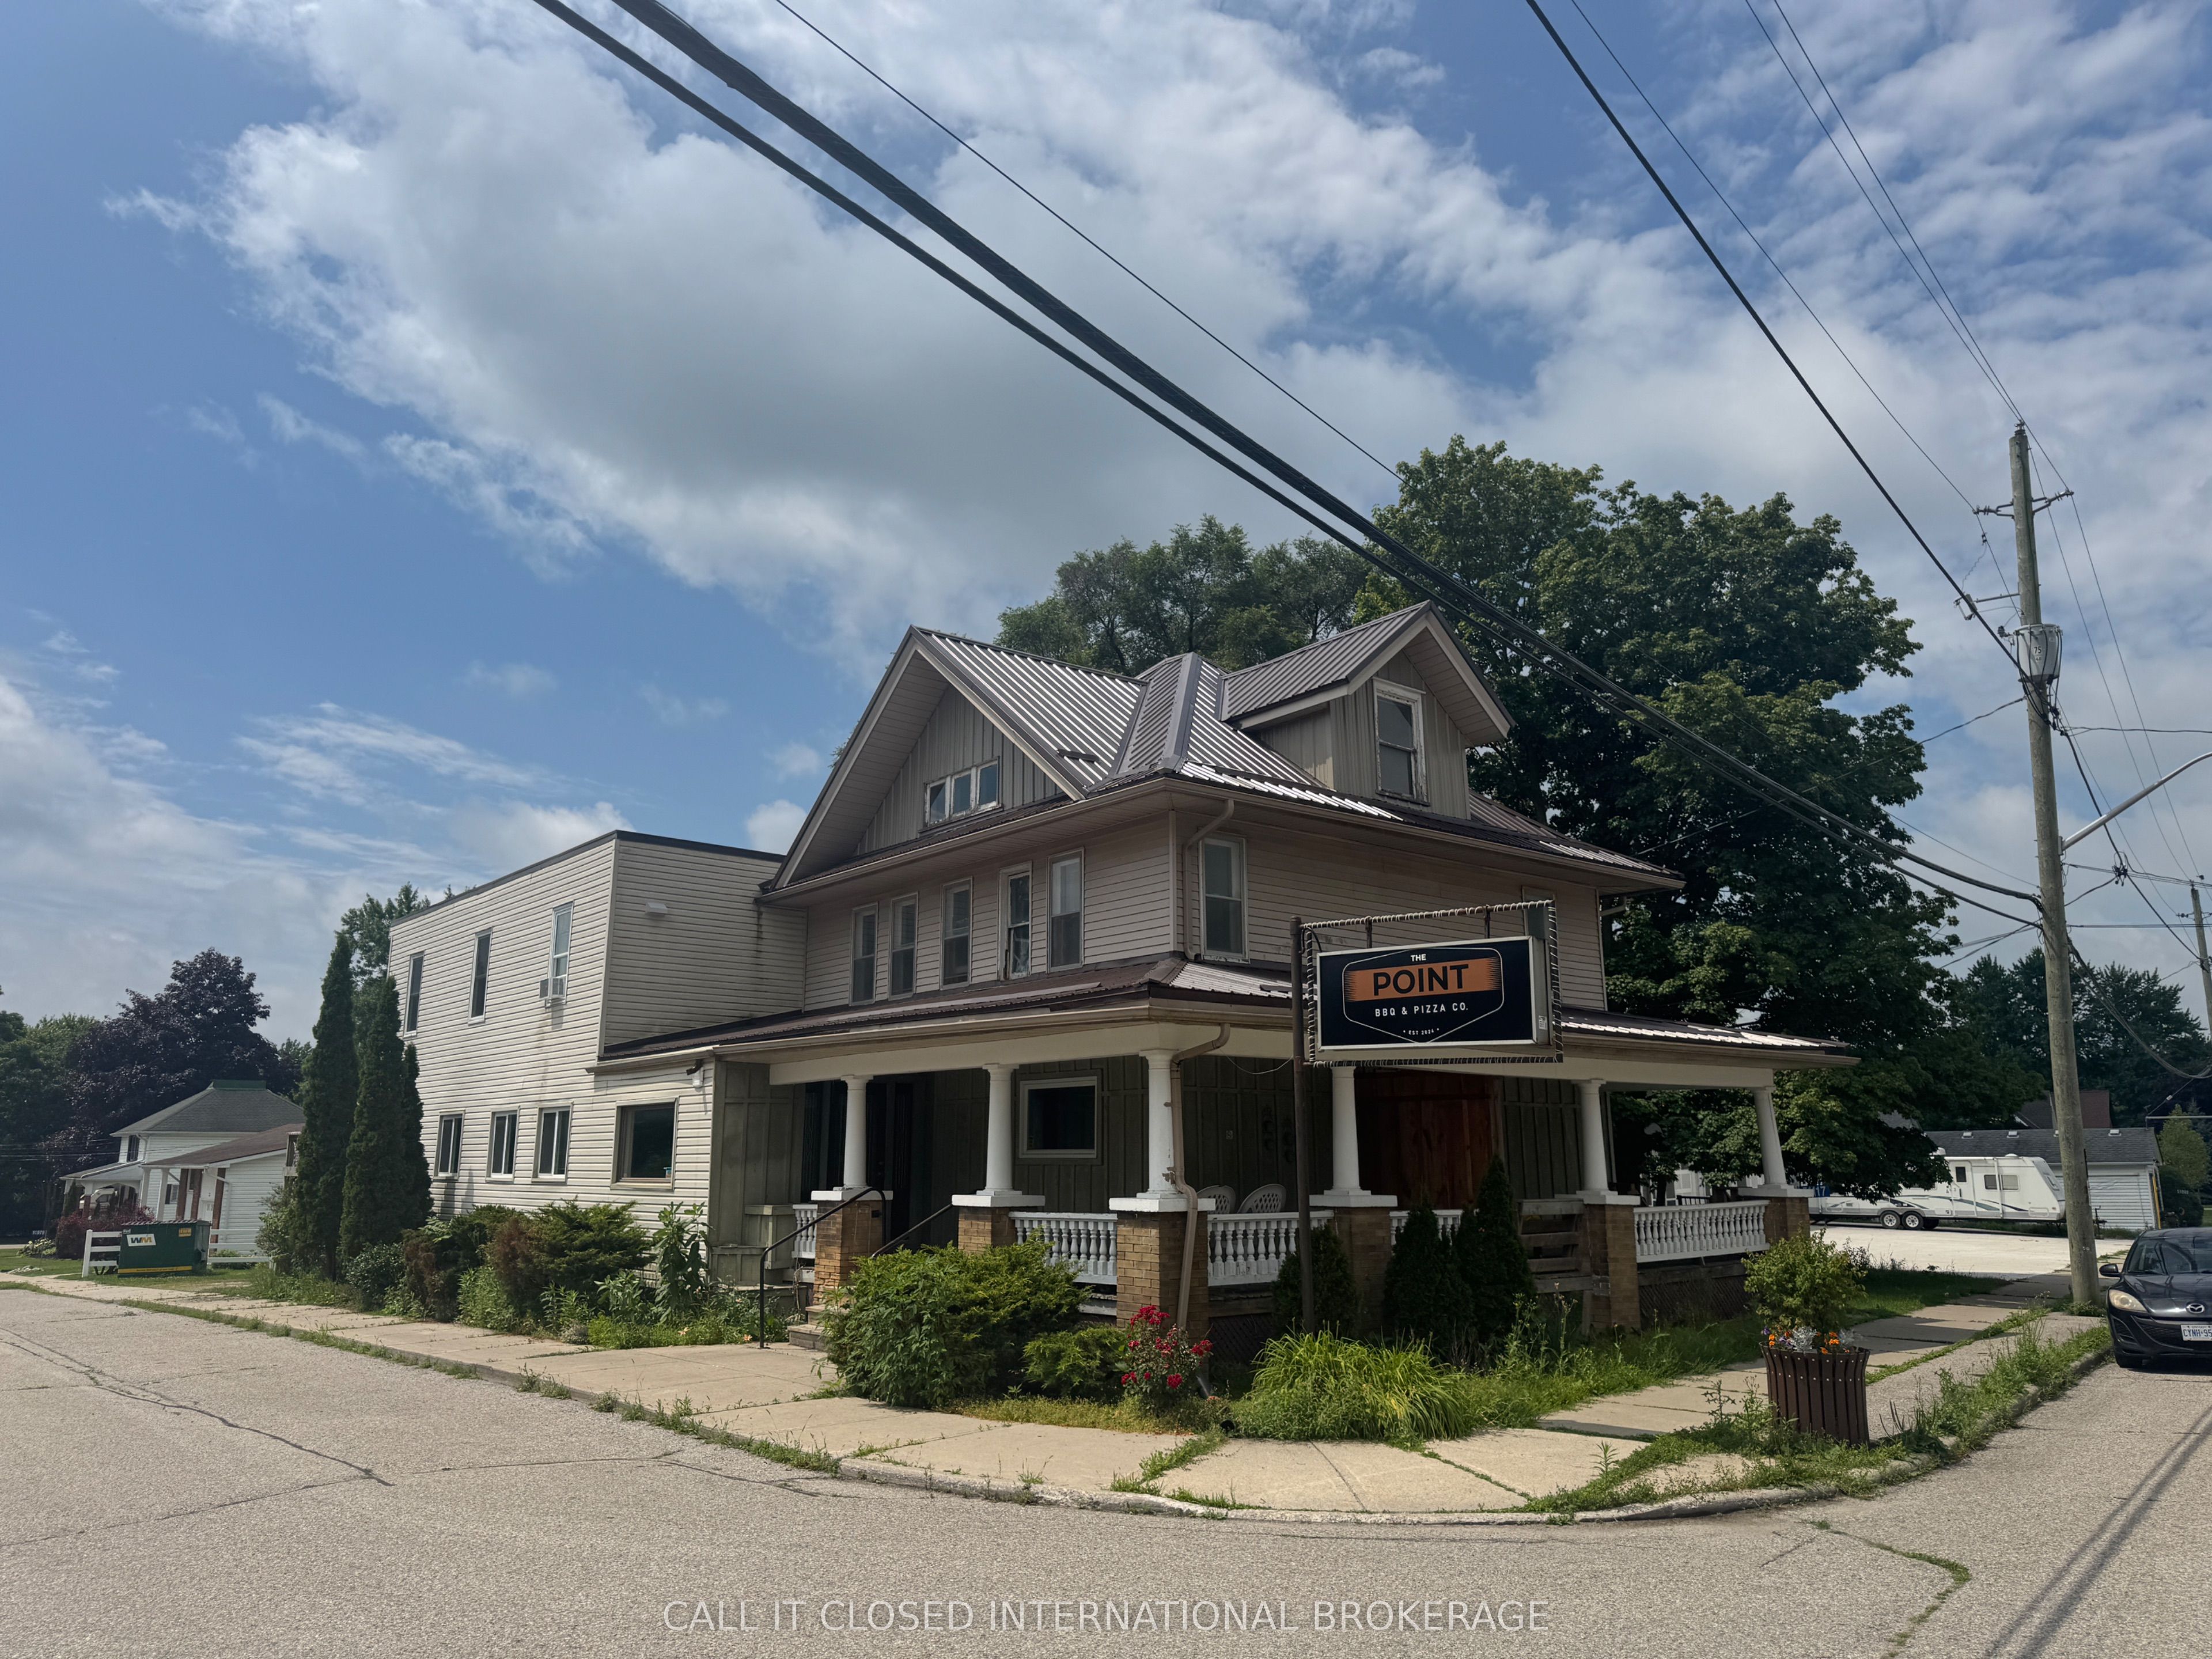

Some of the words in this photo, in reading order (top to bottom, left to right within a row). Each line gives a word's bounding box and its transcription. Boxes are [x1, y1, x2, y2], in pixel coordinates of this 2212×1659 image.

[1373, 964, 1468, 996] POINT
[1375, 1008, 1395, 1017] BBQ
[1402, 1006, 1407, 1015] &
[1414, 1004, 1446, 1014] PIZZA
[1452, 1002, 1468, 1011] CO.
